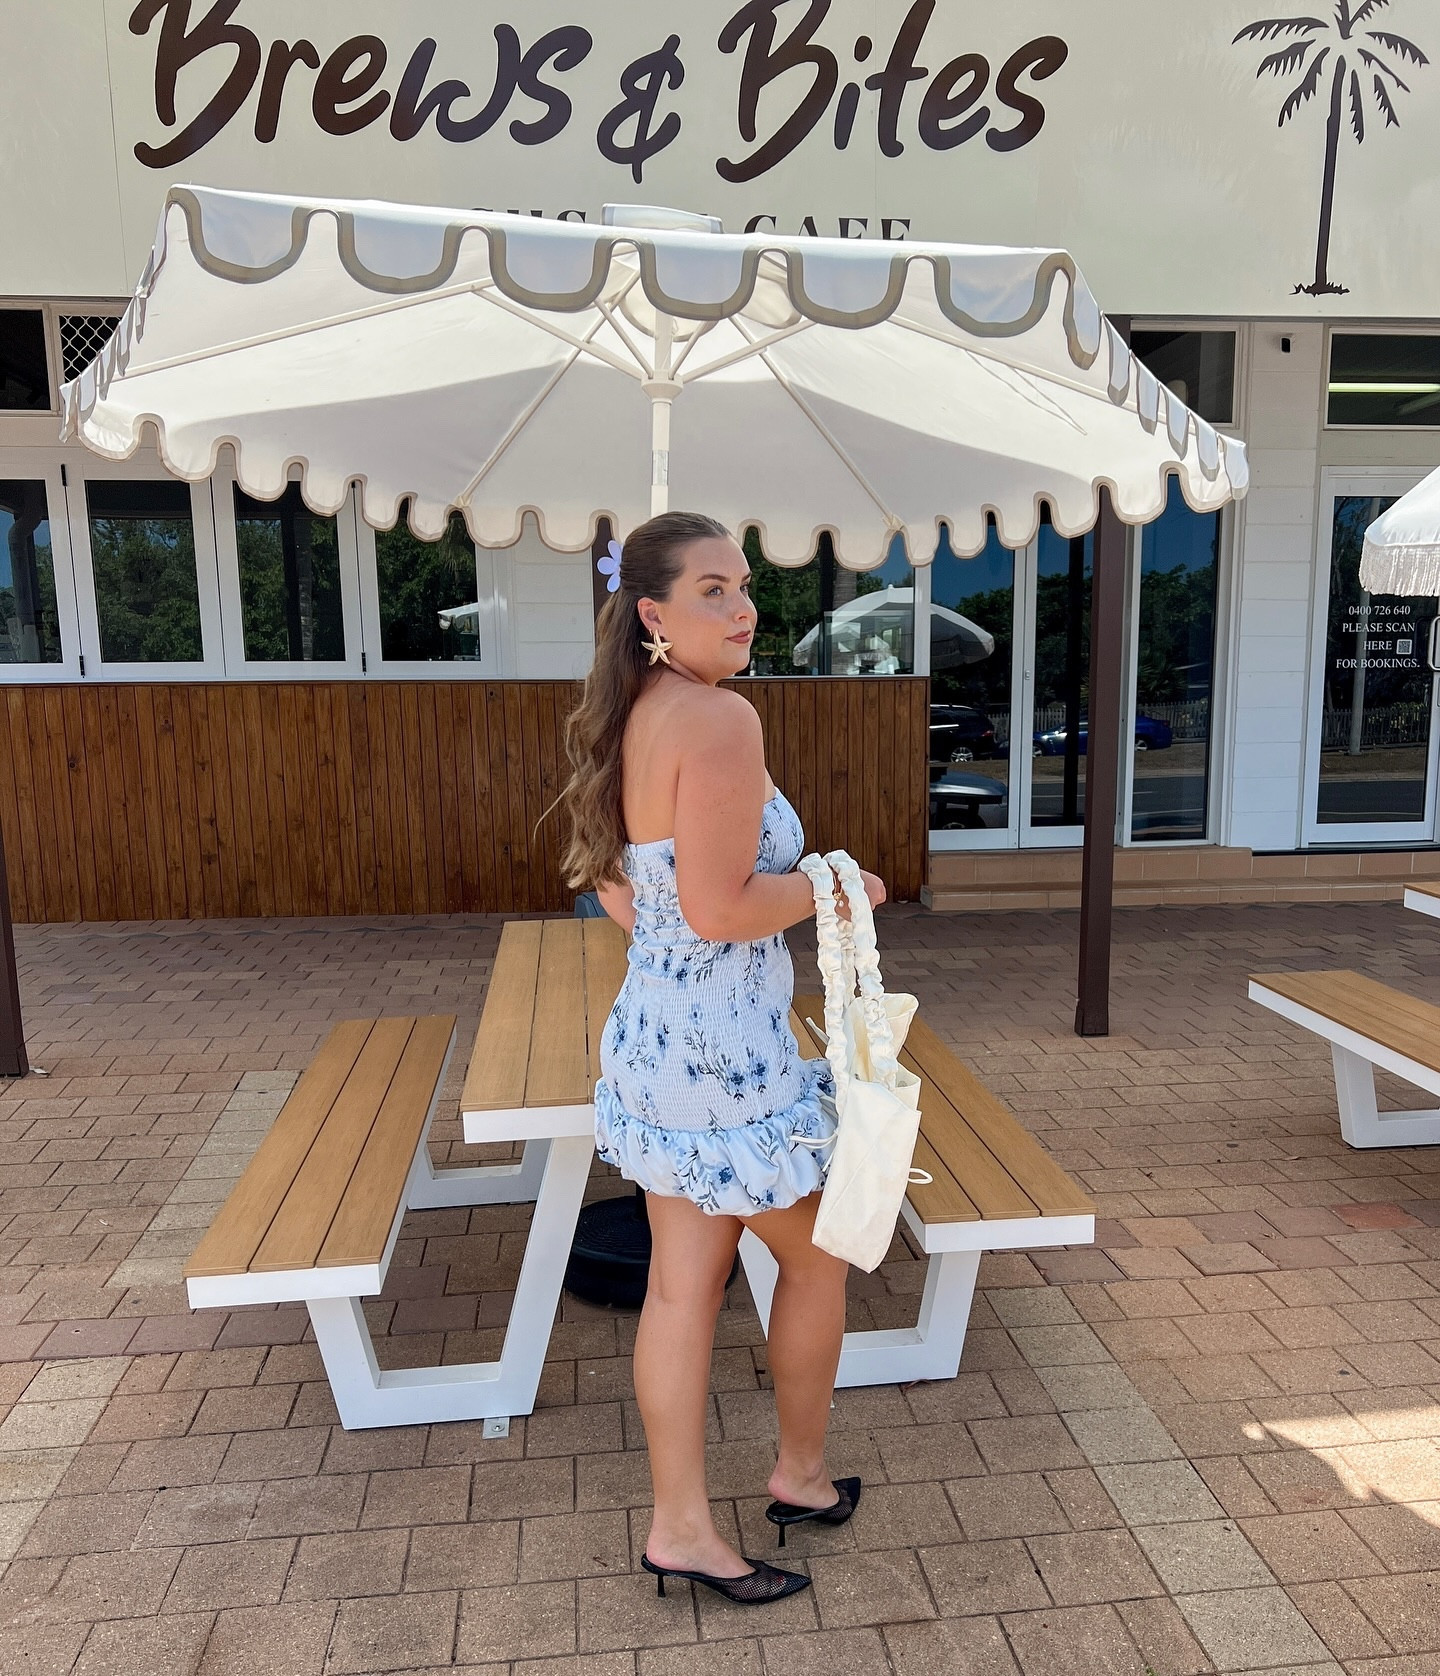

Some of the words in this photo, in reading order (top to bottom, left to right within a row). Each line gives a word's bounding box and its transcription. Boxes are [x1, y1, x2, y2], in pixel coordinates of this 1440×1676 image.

[129, 0, 592, 169] Brews
[597, 34, 685, 184] &
[716, 0, 1069, 183] Bites
[1348, 605, 1372, 616] 0400
[1374, 605, 1391, 616] 726
[1393, 605, 1411, 616] 640
[1342, 622, 1383, 633] PLEASE
[1385, 622, 1416, 633] SCAN
[1363, 640, 1393, 651] HERE
[1336, 658, 1358, 669] FOR
[1360, 658, 1421, 669] BOOKINGS.
